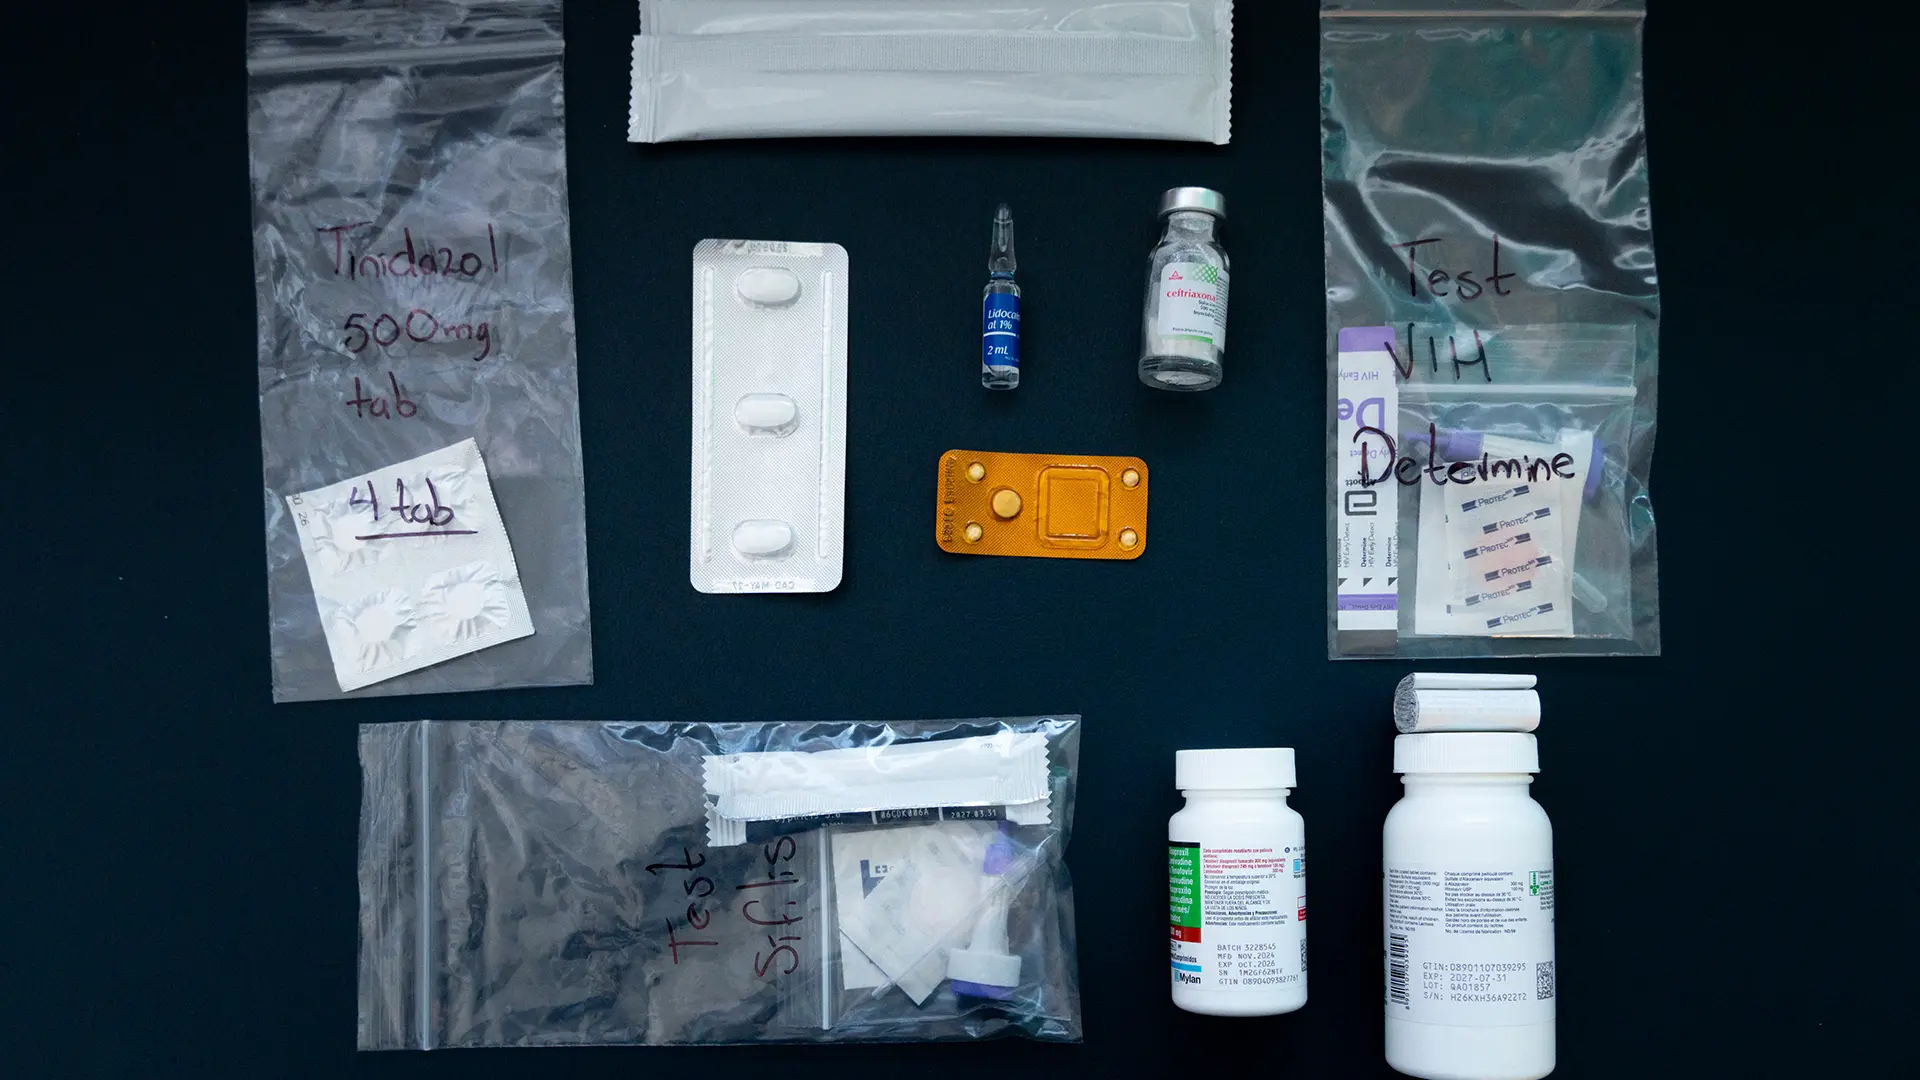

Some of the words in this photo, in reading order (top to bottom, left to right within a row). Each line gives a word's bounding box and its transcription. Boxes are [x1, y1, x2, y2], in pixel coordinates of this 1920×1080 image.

[317, 221, 499, 280] Tinidazol
[1392, 234, 1516, 297] Test
[1166, 288, 1217, 302] ceftriaxona
[988, 309, 1020, 321] Lidoca
[988, 320, 996, 330] al
[1000, 320, 1012, 330] 1%
[987, 345, 994, 355] 2
[994, 345, 1009, 355] mL
[1385, 322, 1492, 383] VIH
[1338, 369, 1359, 381] Early
[1361, 371, 1379, 381] HIV
[347, 371, 417, 420] tab
[1350, 450, 1377, 459] Deect
[1353, 423, 1576, 489] Determine
[350, 480, 379, 521] 4
[390, 477, 455, 526] tab
[298, 511, 310, 527] 26
[951, 809, 997, 818] 2027.03.31
[646, 847, 718, 965] Test
[1244, 943, 1276, 951] 3228545
[1238, 952, 1275, 960] NOV.2024
[1238, 960, 1275, 968] OCT.2026
[1179, 973, 1201, 984] Mylan
[1424, 972, 1444, 982] EXP:
[1450, 974, 1507, 982] 2027-07-31
[1424, 982, 1444, 990] LOT:
[1424, 991, 1444, 1000] S/N:
